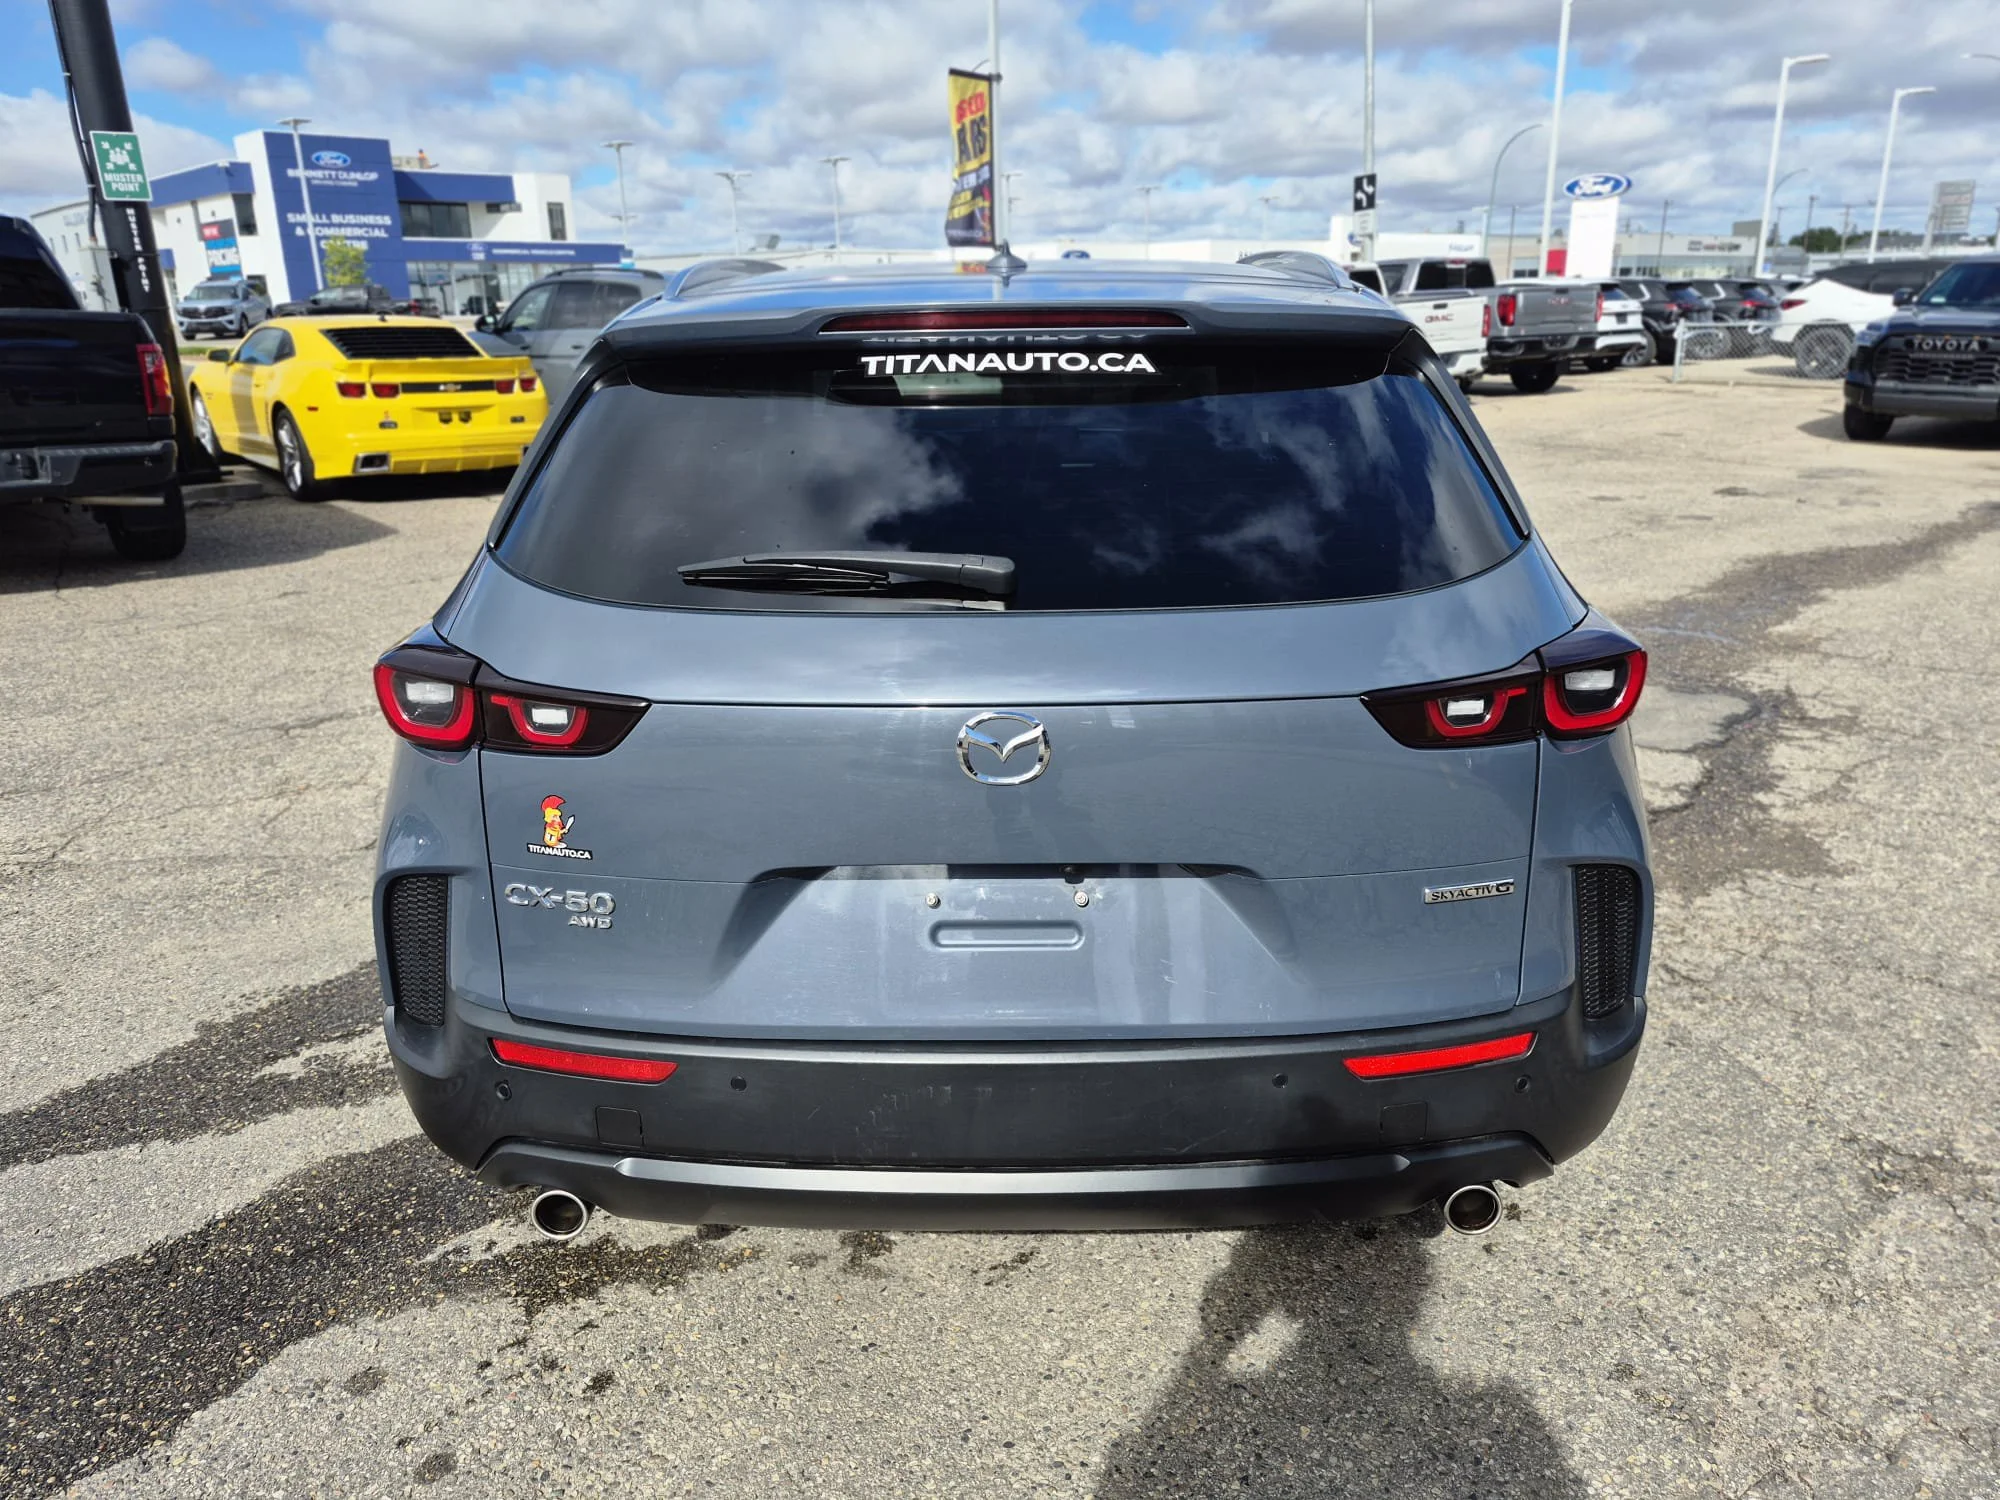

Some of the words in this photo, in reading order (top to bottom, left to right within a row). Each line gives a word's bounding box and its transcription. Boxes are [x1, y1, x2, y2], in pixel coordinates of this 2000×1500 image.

[103, 172, 144, 183] MUSTER
[286, 168, 337, 179] BENETT
[111, 182, 140, 193] POINT
[330, 213, 392, 226] BUSINESS
[126, 207, 143, 252] MUSTER
[137, 256, 150, 293] POINT
[1914, 338, 1980, 351] TOYOTA
[861, 352, 1156, 375] TITANAUTO.CA
[528, 845, 591, 859] TITANAUTO.CA
[504, 883, 616, 915] CX-50
[568, 915, 612, 929] AWD
